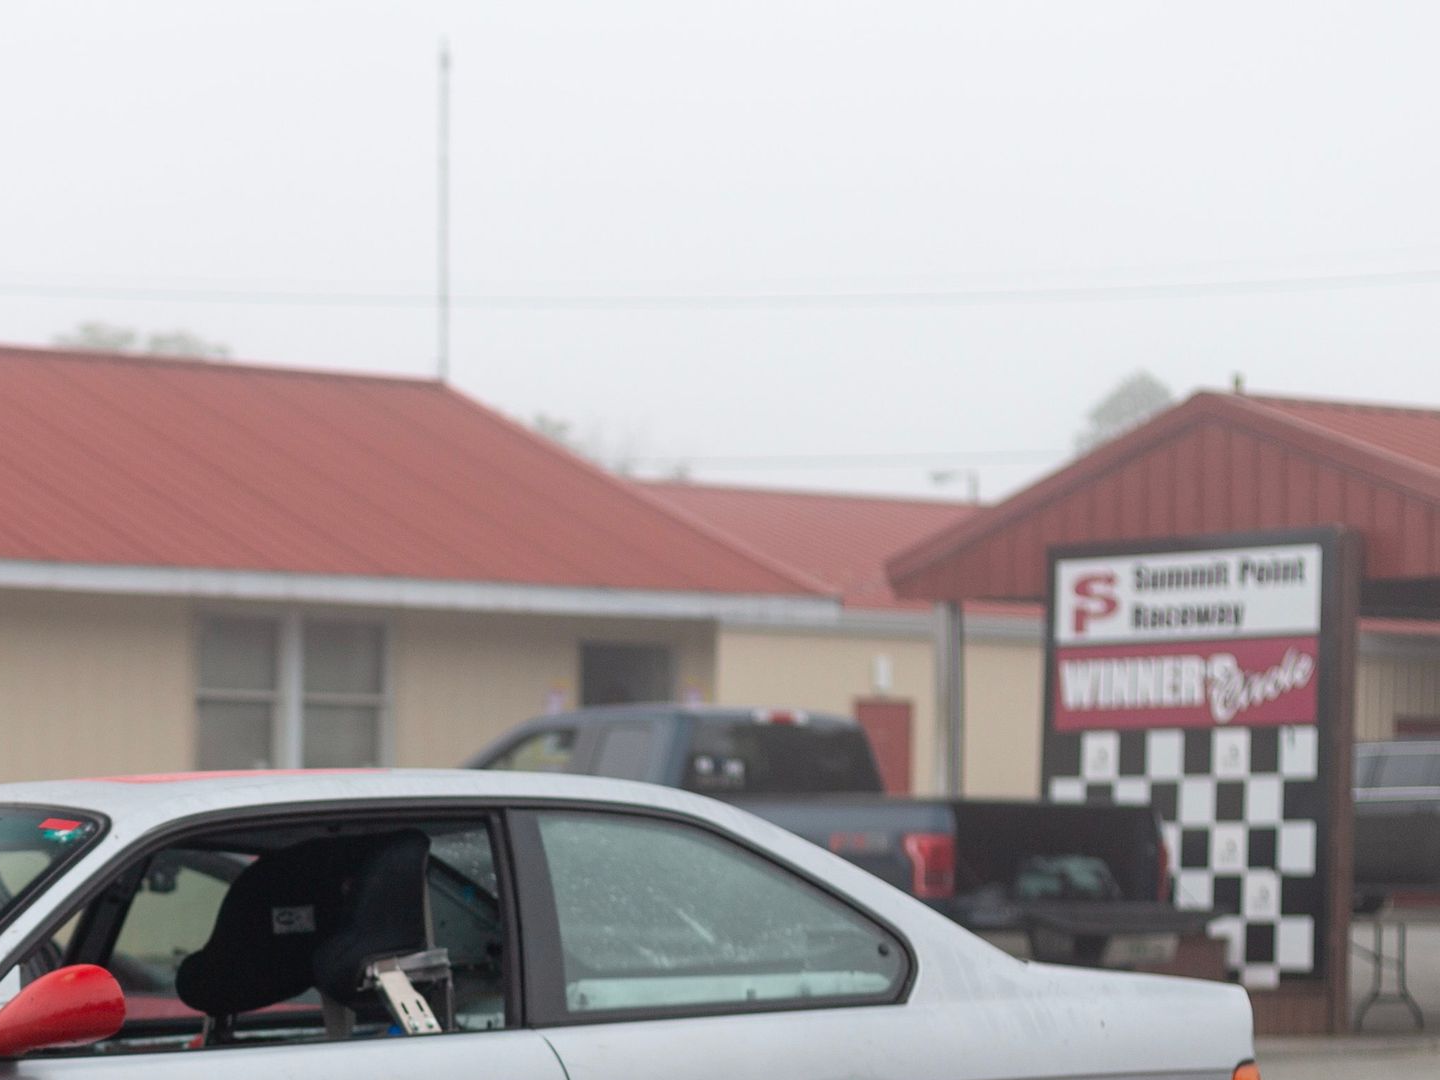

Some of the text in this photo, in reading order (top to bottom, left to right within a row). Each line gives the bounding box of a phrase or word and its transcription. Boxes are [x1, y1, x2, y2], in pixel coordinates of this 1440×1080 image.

[1133, 556, 1306, 591] Summit Point
[1131, 603, 1244, 630] Raceway
